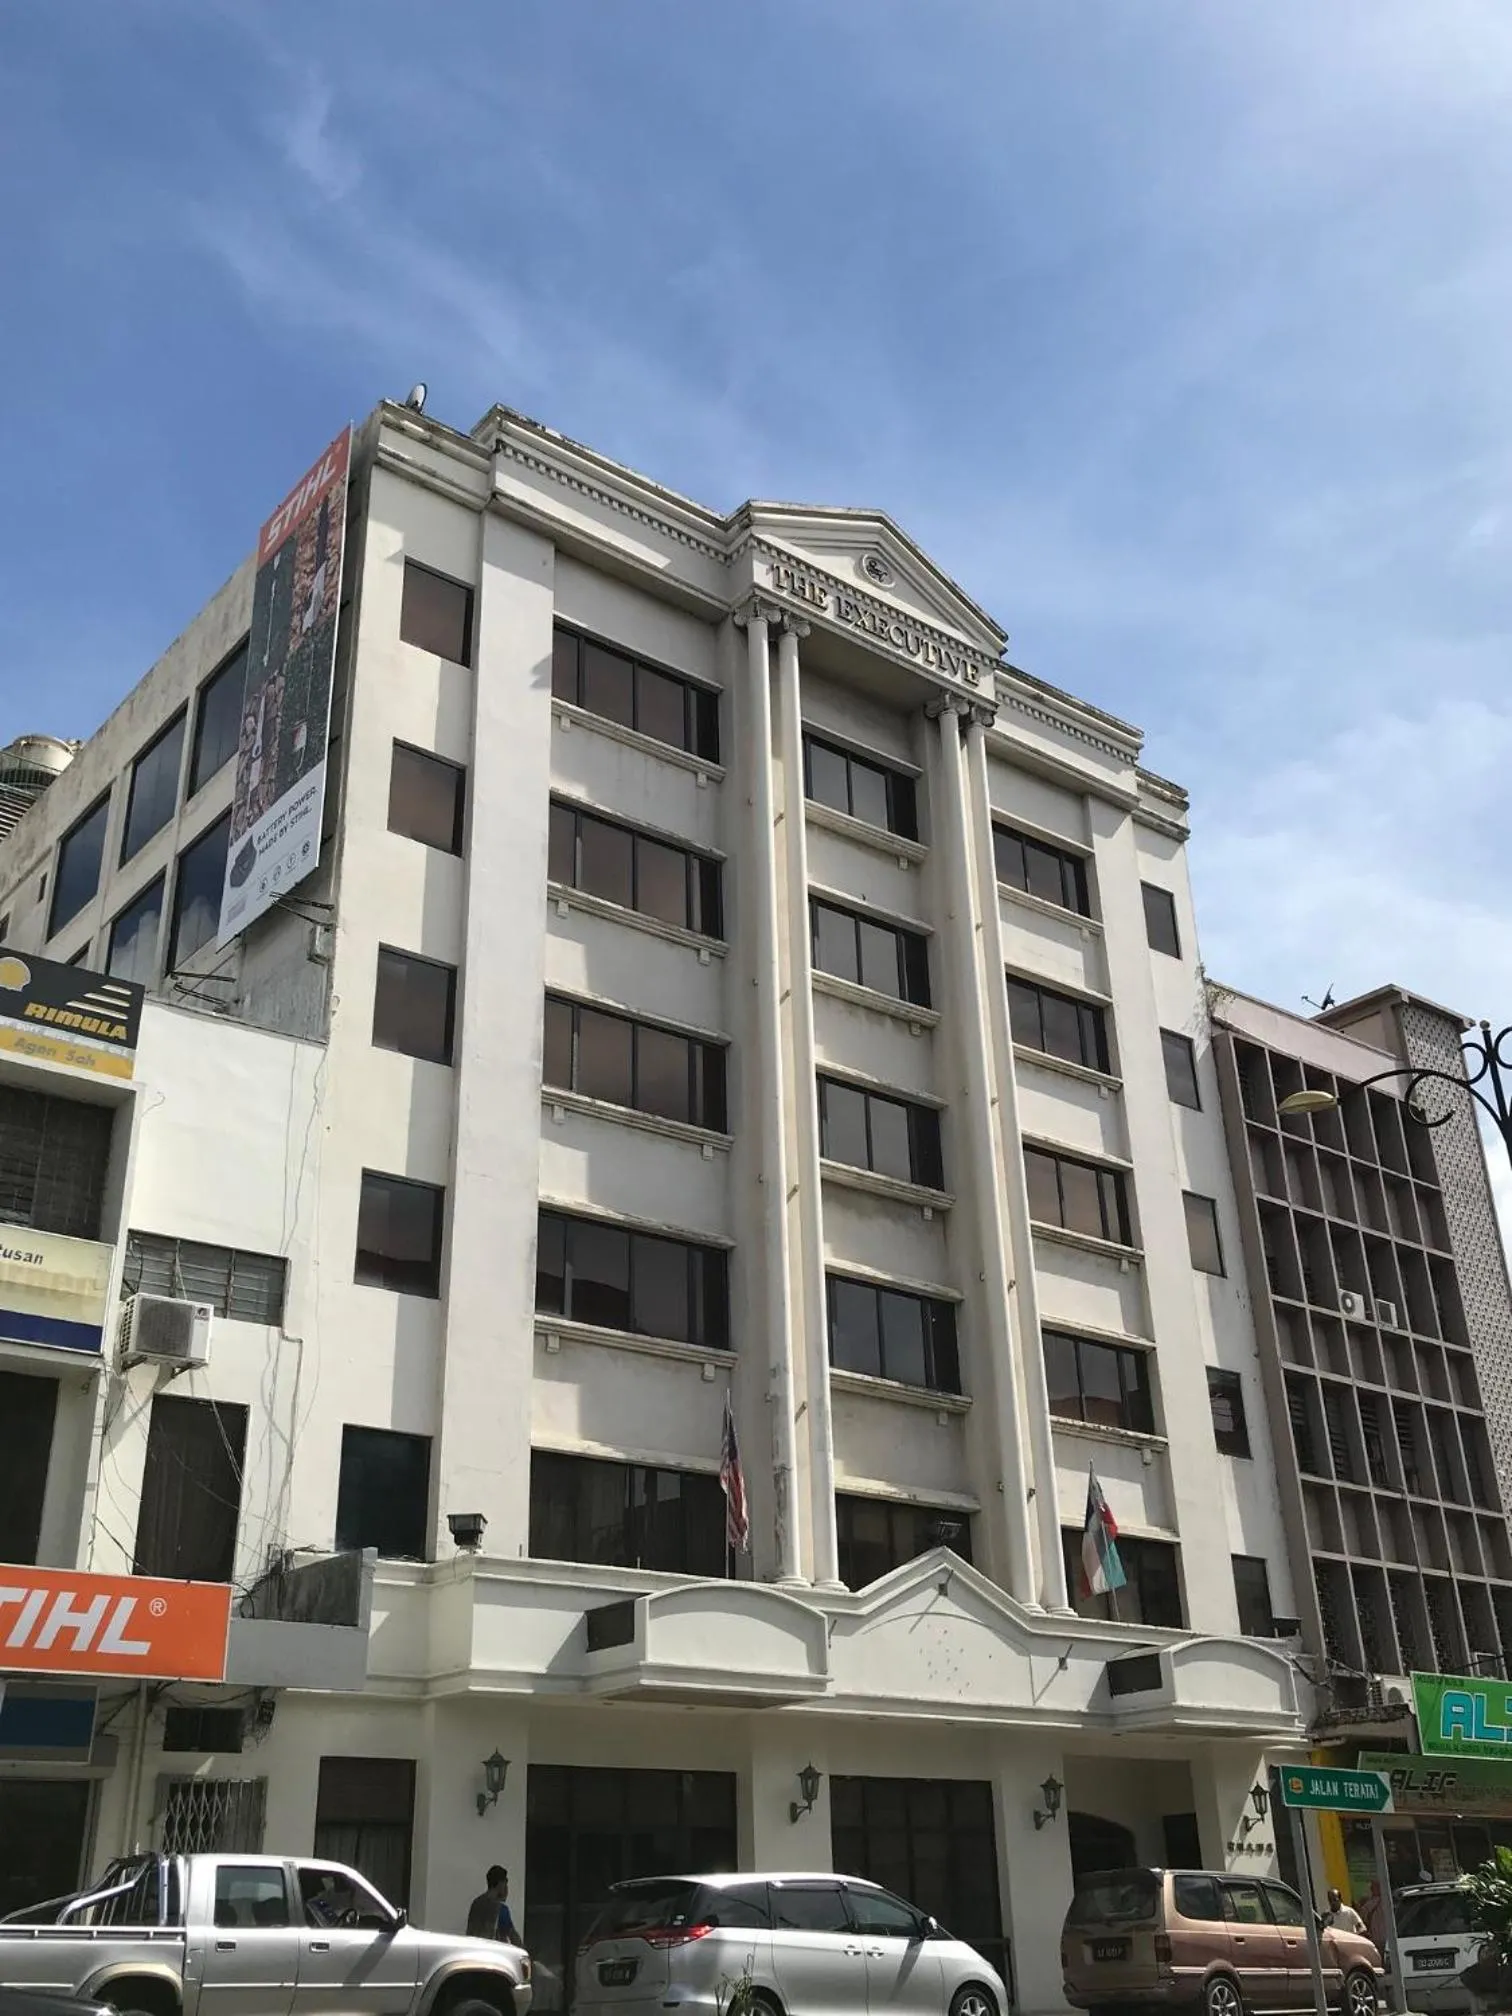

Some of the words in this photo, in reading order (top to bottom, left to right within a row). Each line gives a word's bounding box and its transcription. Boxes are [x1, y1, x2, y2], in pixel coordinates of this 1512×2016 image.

[264, 453, 337, 553] STIHL
[772, 563, 828, 611] THE
[836, 595, 980, 687] EXECUTIVE
[24, 1002, 128, 1040] RIMULA
[1309, 1779, 1339, 1797] JALAN
[1343, 1781, 1380, 1800] TERATAI
